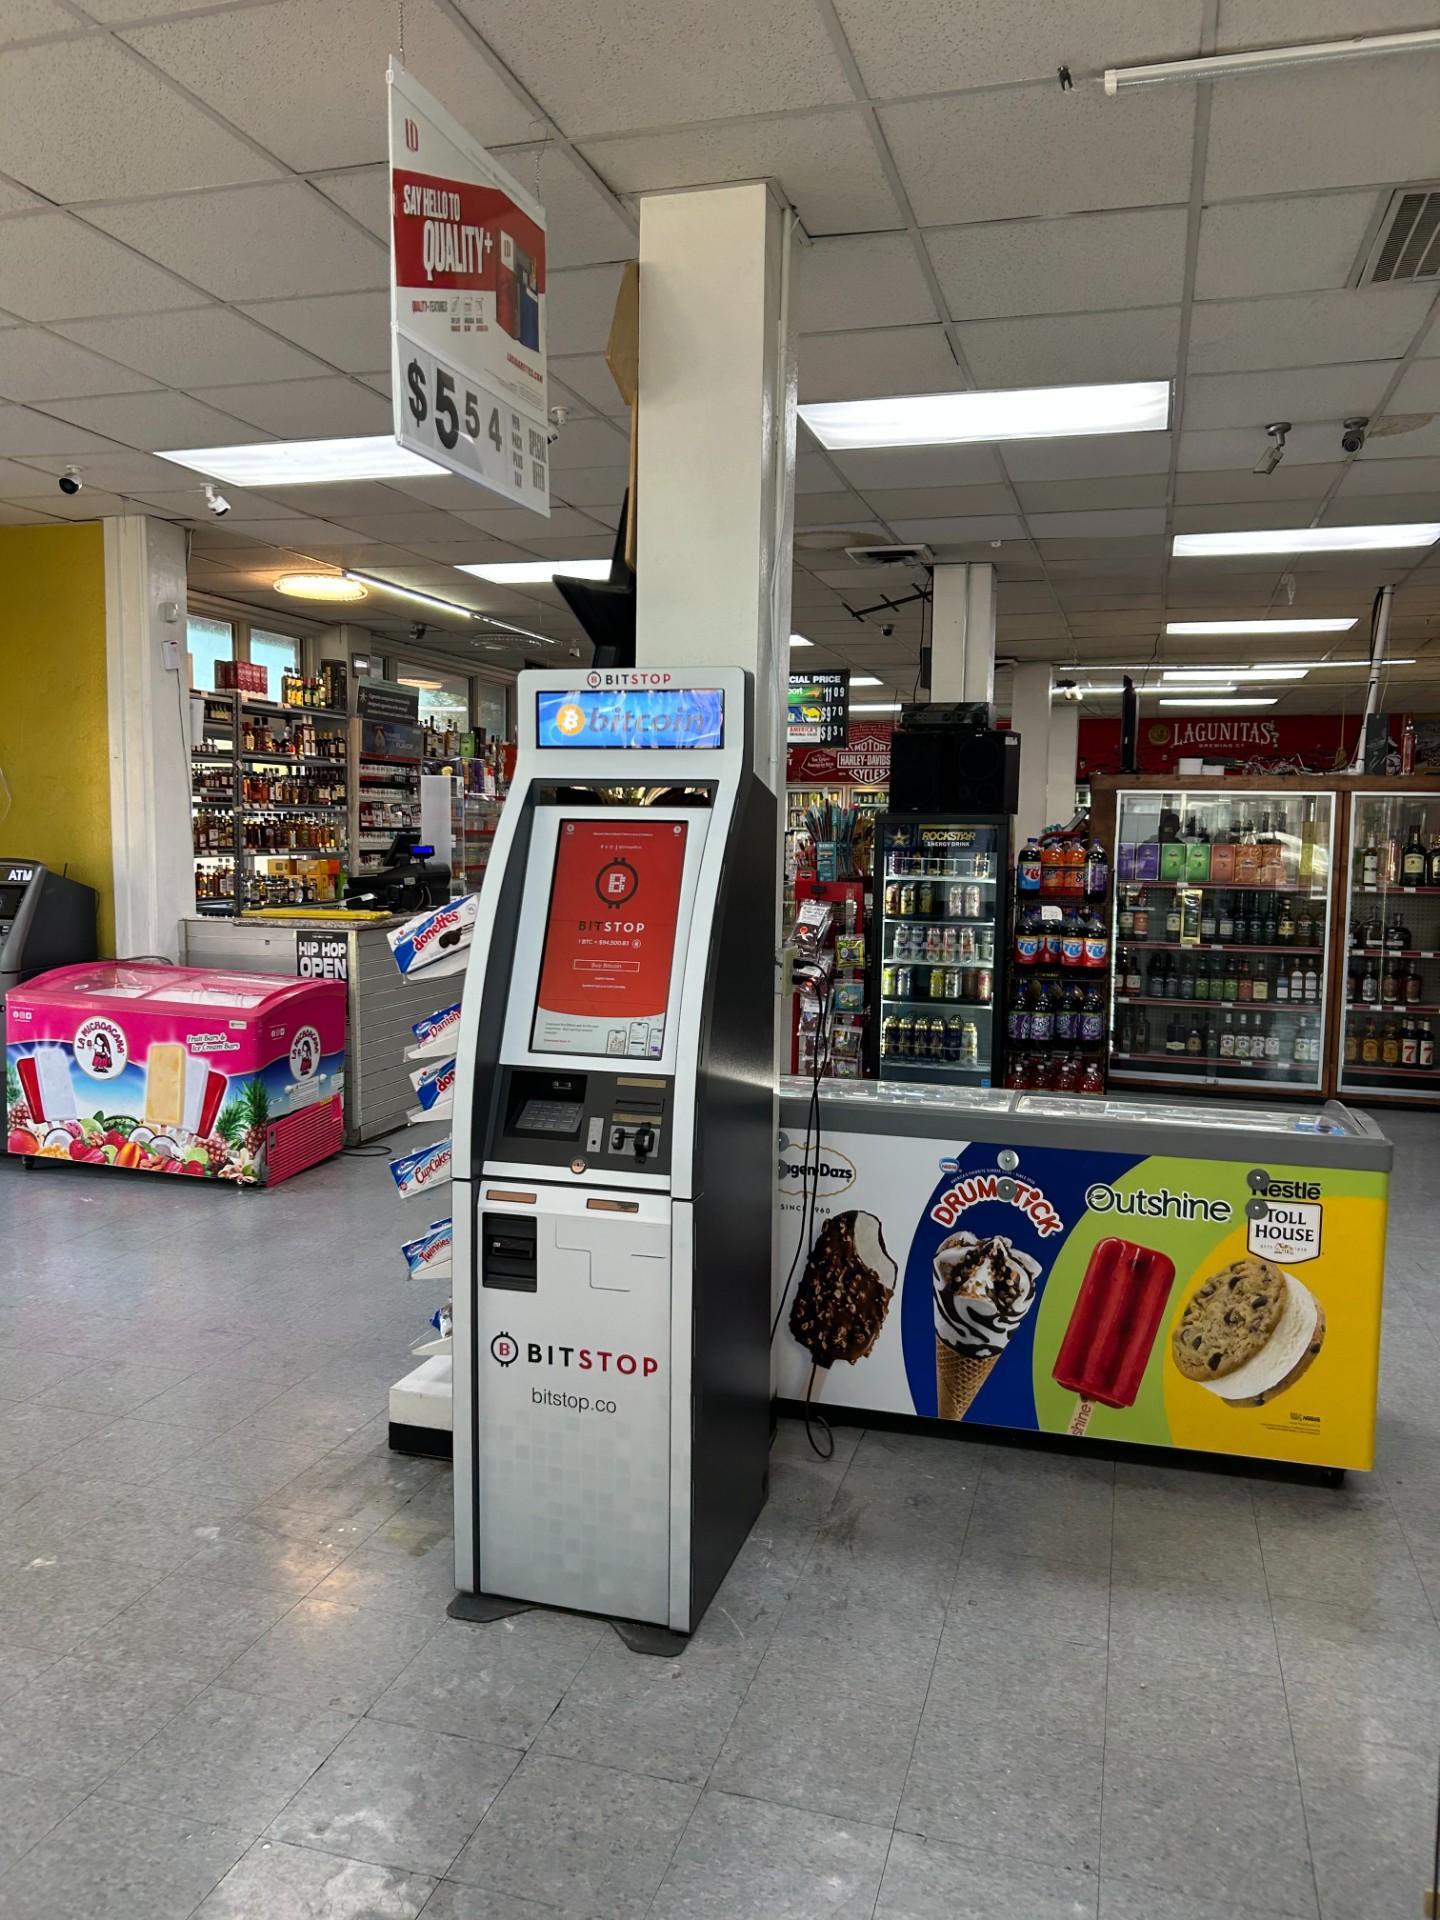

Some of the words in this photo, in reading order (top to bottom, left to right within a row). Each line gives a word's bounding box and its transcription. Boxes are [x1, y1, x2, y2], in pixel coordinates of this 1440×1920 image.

[403, 184, 422, 216] SAY
[423, 187, 448, 220] HELLO
[449, 192, 461, 222] TO
[605, 673, 672, 685] BITSTOP
[789, 675, 810, 684] CIAL
[812, 675, 841, 684] PRICE
[589, 704, 705, 733] bitcoin
[1173, 722, 1271, 746] LAGUNITAS
[854, 740, 887, 751] MOTOR
[840, 754, 891, 766] HARLEY-DAVIDS
[853, 768, 886, 782] CYCLES
[921, 831, 976, 841] ROCKSTAR
[8, 869, 33, 881] ATM
[413, 911, 459, 952] donettes
[578, 920, 645, 933] BITSTOP
[299, 941, 319, 956] HIP
[321, 942, 347, 957] HOP
[300, 956, 347, 979] OPEN
[77, 1038, 86, 1049] LA
[203, 1034, 218, 1042] Bars
[192, 1043, 201, 1051] Ice
[202, 1042, 224, 1051] Cream
[224, 1042, 239, 1050] Bars
[414, 1150, 452, 1184] CupCakes
[780, 1203, 801, 1212] SINC
[814, 1206, 831, 1214] 960
[932, 1177, 1062, 1236] DRUMTICK
[1086, 1184, 1231, 1221] Outshine
[1267, 1208, 1307, 1225] TOLL
[1255, 1224, 1314, 1242] HOUSE
[419, 1238, 450, 1263] Twinkies
[527, 1343, 659, 1377] BITSTOP
[531, 1387, 617, 1414] bitstop.co
